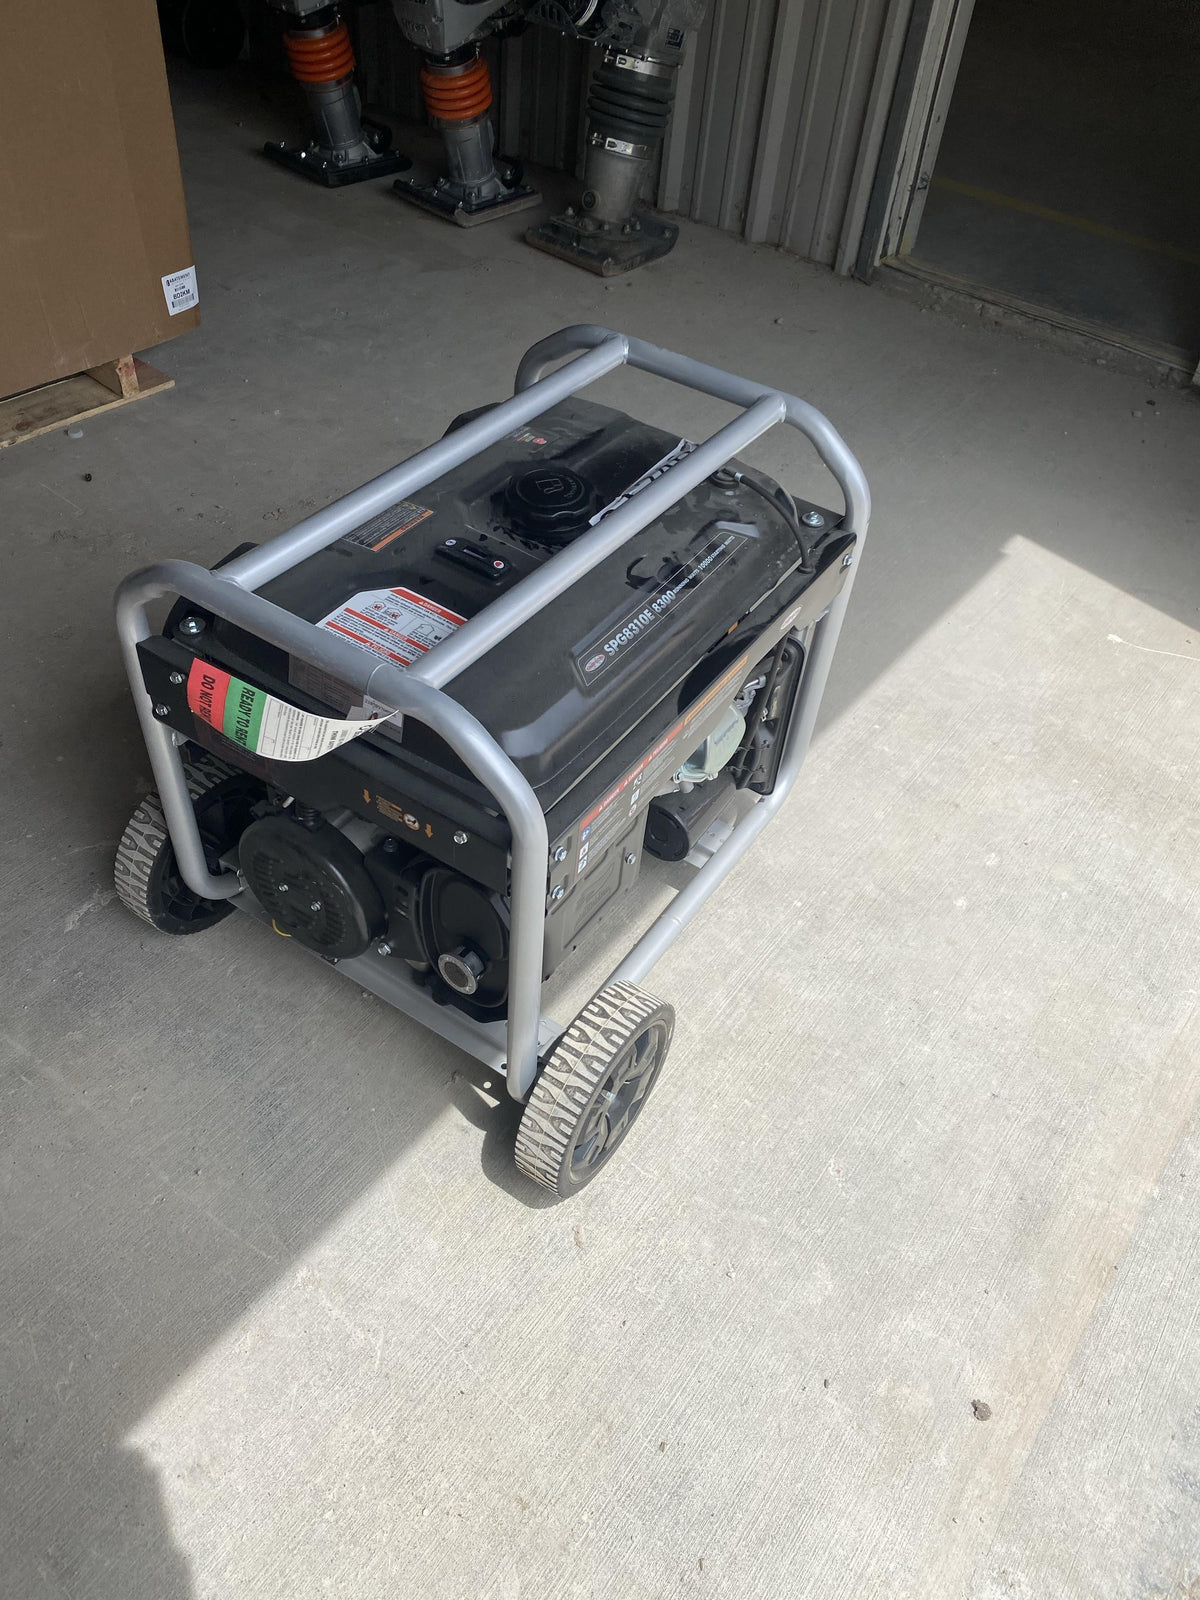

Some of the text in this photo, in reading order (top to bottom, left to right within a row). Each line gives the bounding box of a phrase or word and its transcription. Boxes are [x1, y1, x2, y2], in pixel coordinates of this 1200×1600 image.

[603, 608, 655, 656] SPG8310E
[651, 590, 676, 613] 8300
[697, 556, 713, 570] 10000
[199, 689, 213, 708] NOT
[200, 674, 216, 690] DO
[234, 686, 256, 746] READY TO RENT
